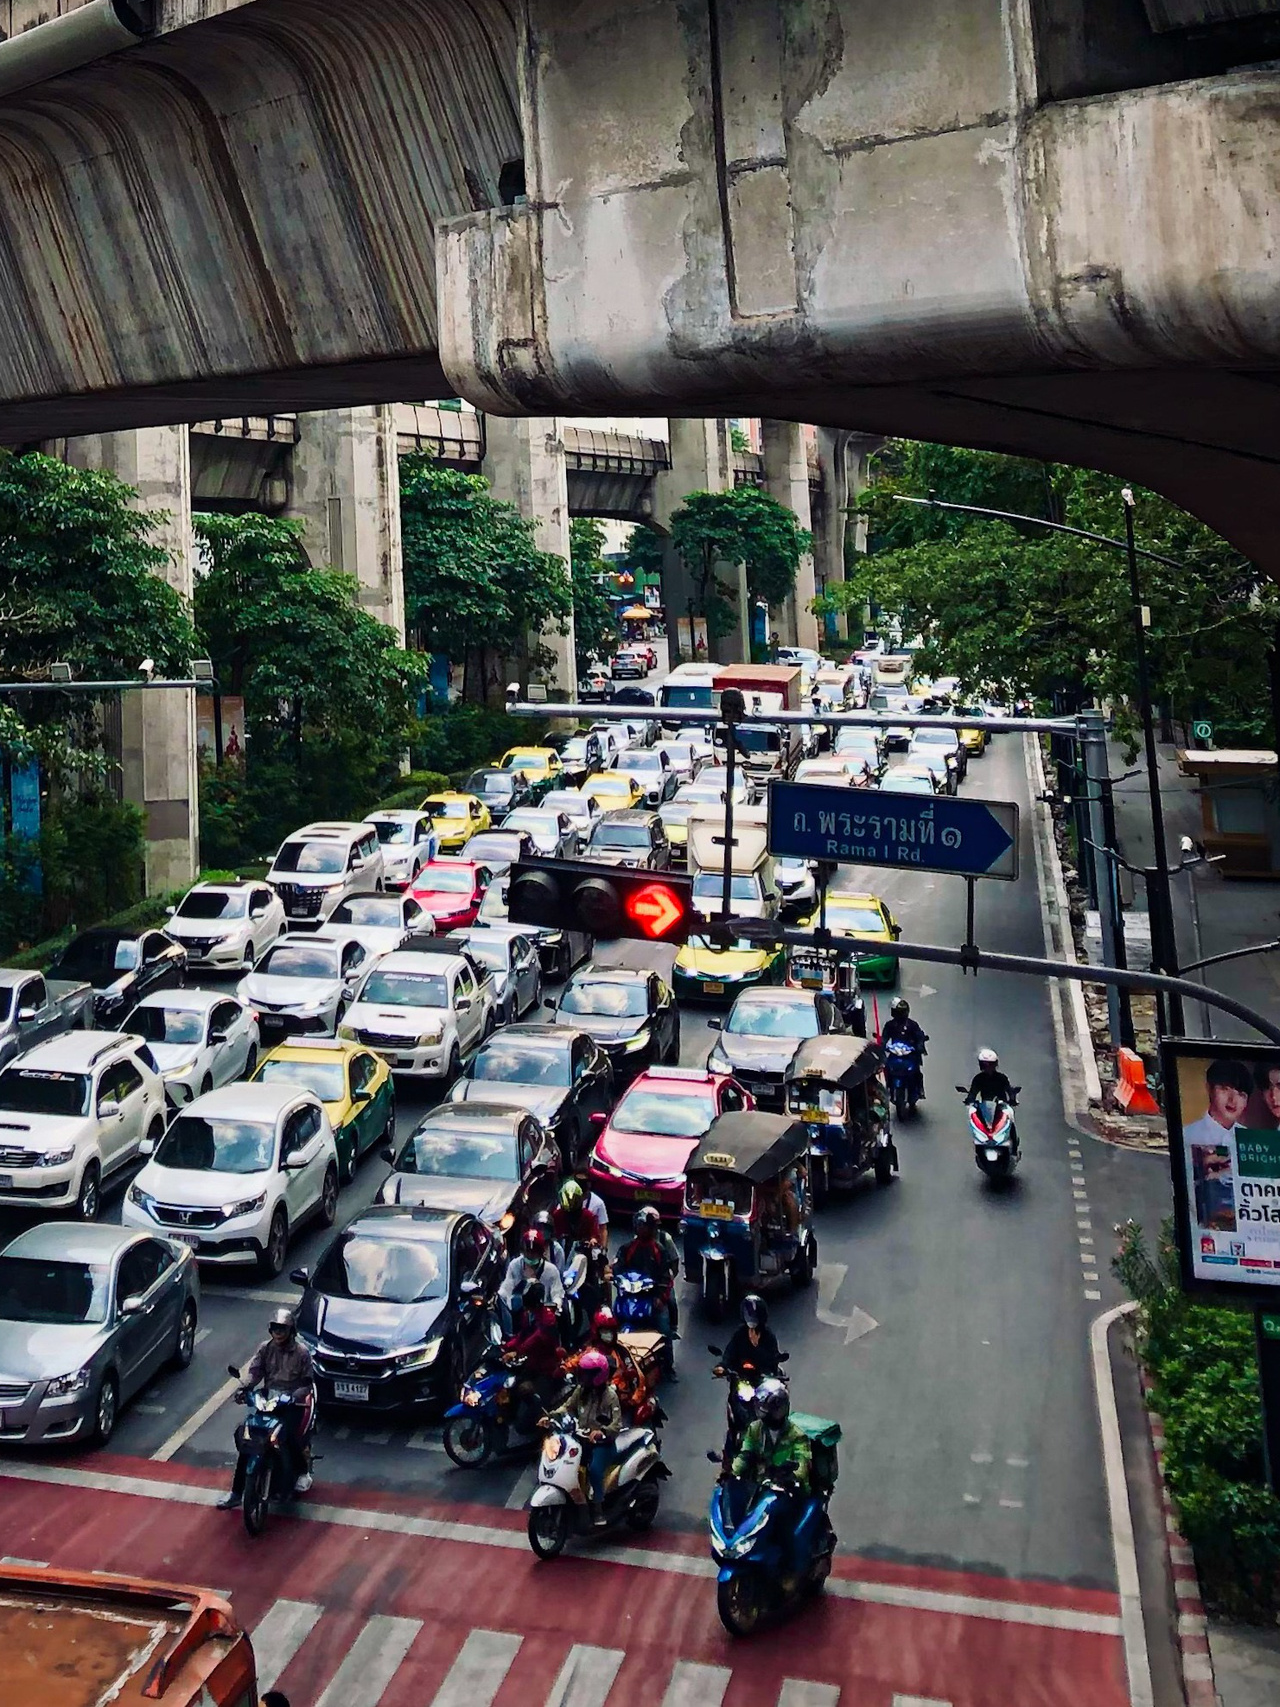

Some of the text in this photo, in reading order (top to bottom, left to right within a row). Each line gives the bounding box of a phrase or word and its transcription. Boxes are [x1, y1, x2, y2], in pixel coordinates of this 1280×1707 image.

[794, 812, 811, 832] ถ.
[827, 839, 876, 857] Rama
[898, 847, 925, 863] Rd.
[1239, 1143, 1270, 1153] BABY
[1240, 1182, 1280, 1198] ตาค
